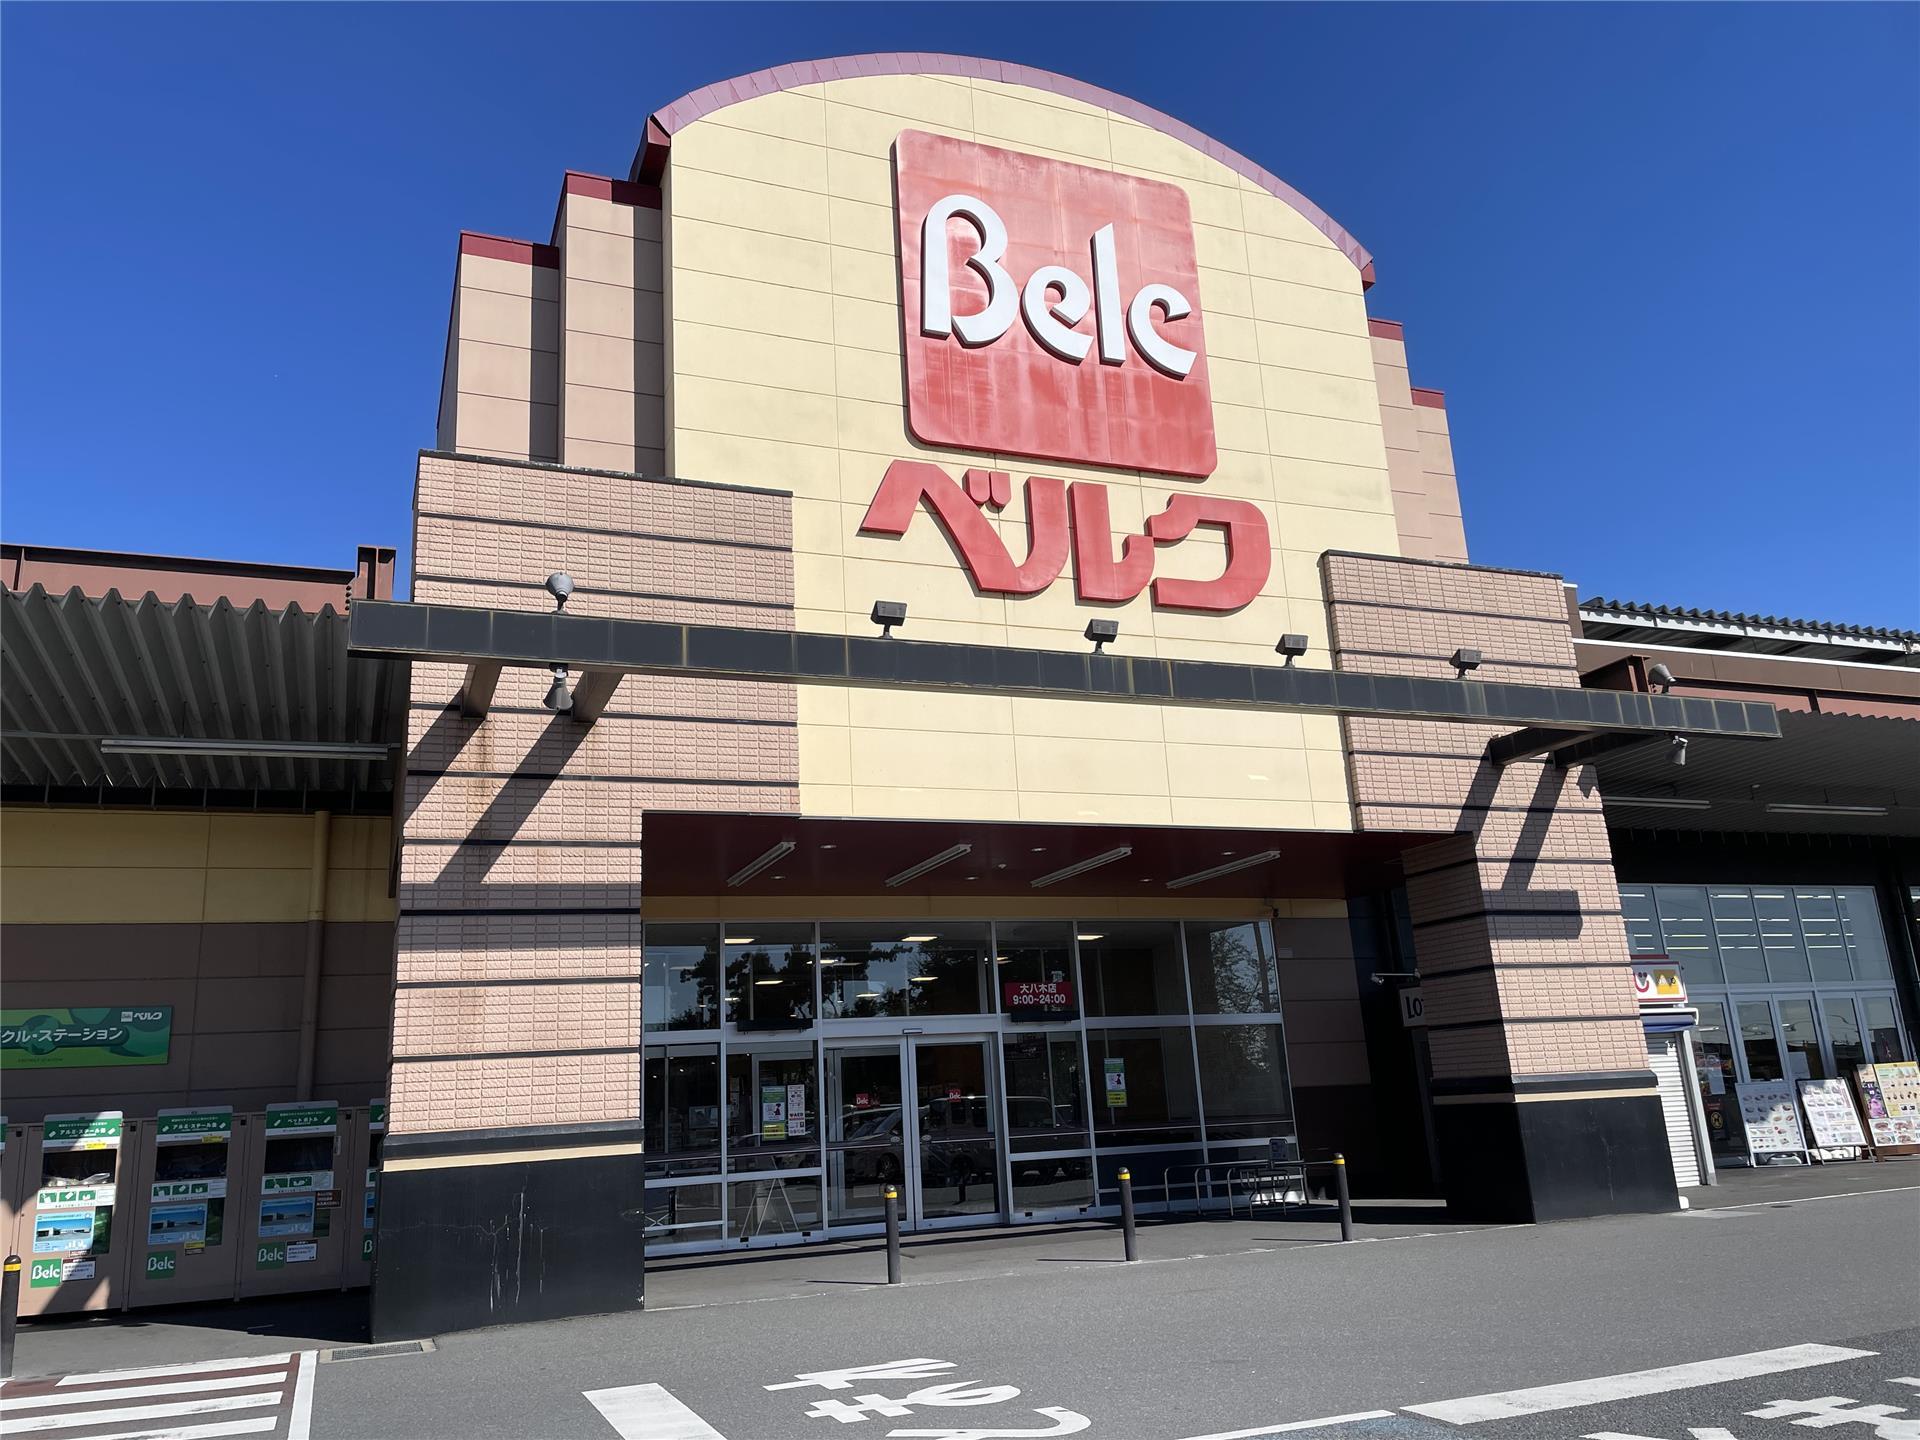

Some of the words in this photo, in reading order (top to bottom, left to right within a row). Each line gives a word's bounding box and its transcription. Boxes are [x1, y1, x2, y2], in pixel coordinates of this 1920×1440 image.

[920, 194, 1198, 381] Belc
[857, 459, 1272, 613] ベルク
[1020, 983, 1057, 993] 大八木店
[133, 1011, 163, 1020] ベルク
[258, 1247, 284, 1262] Belc
[147, 1256, 175, 1271] Belc
[32, 1264, 61, 1280] Belc
